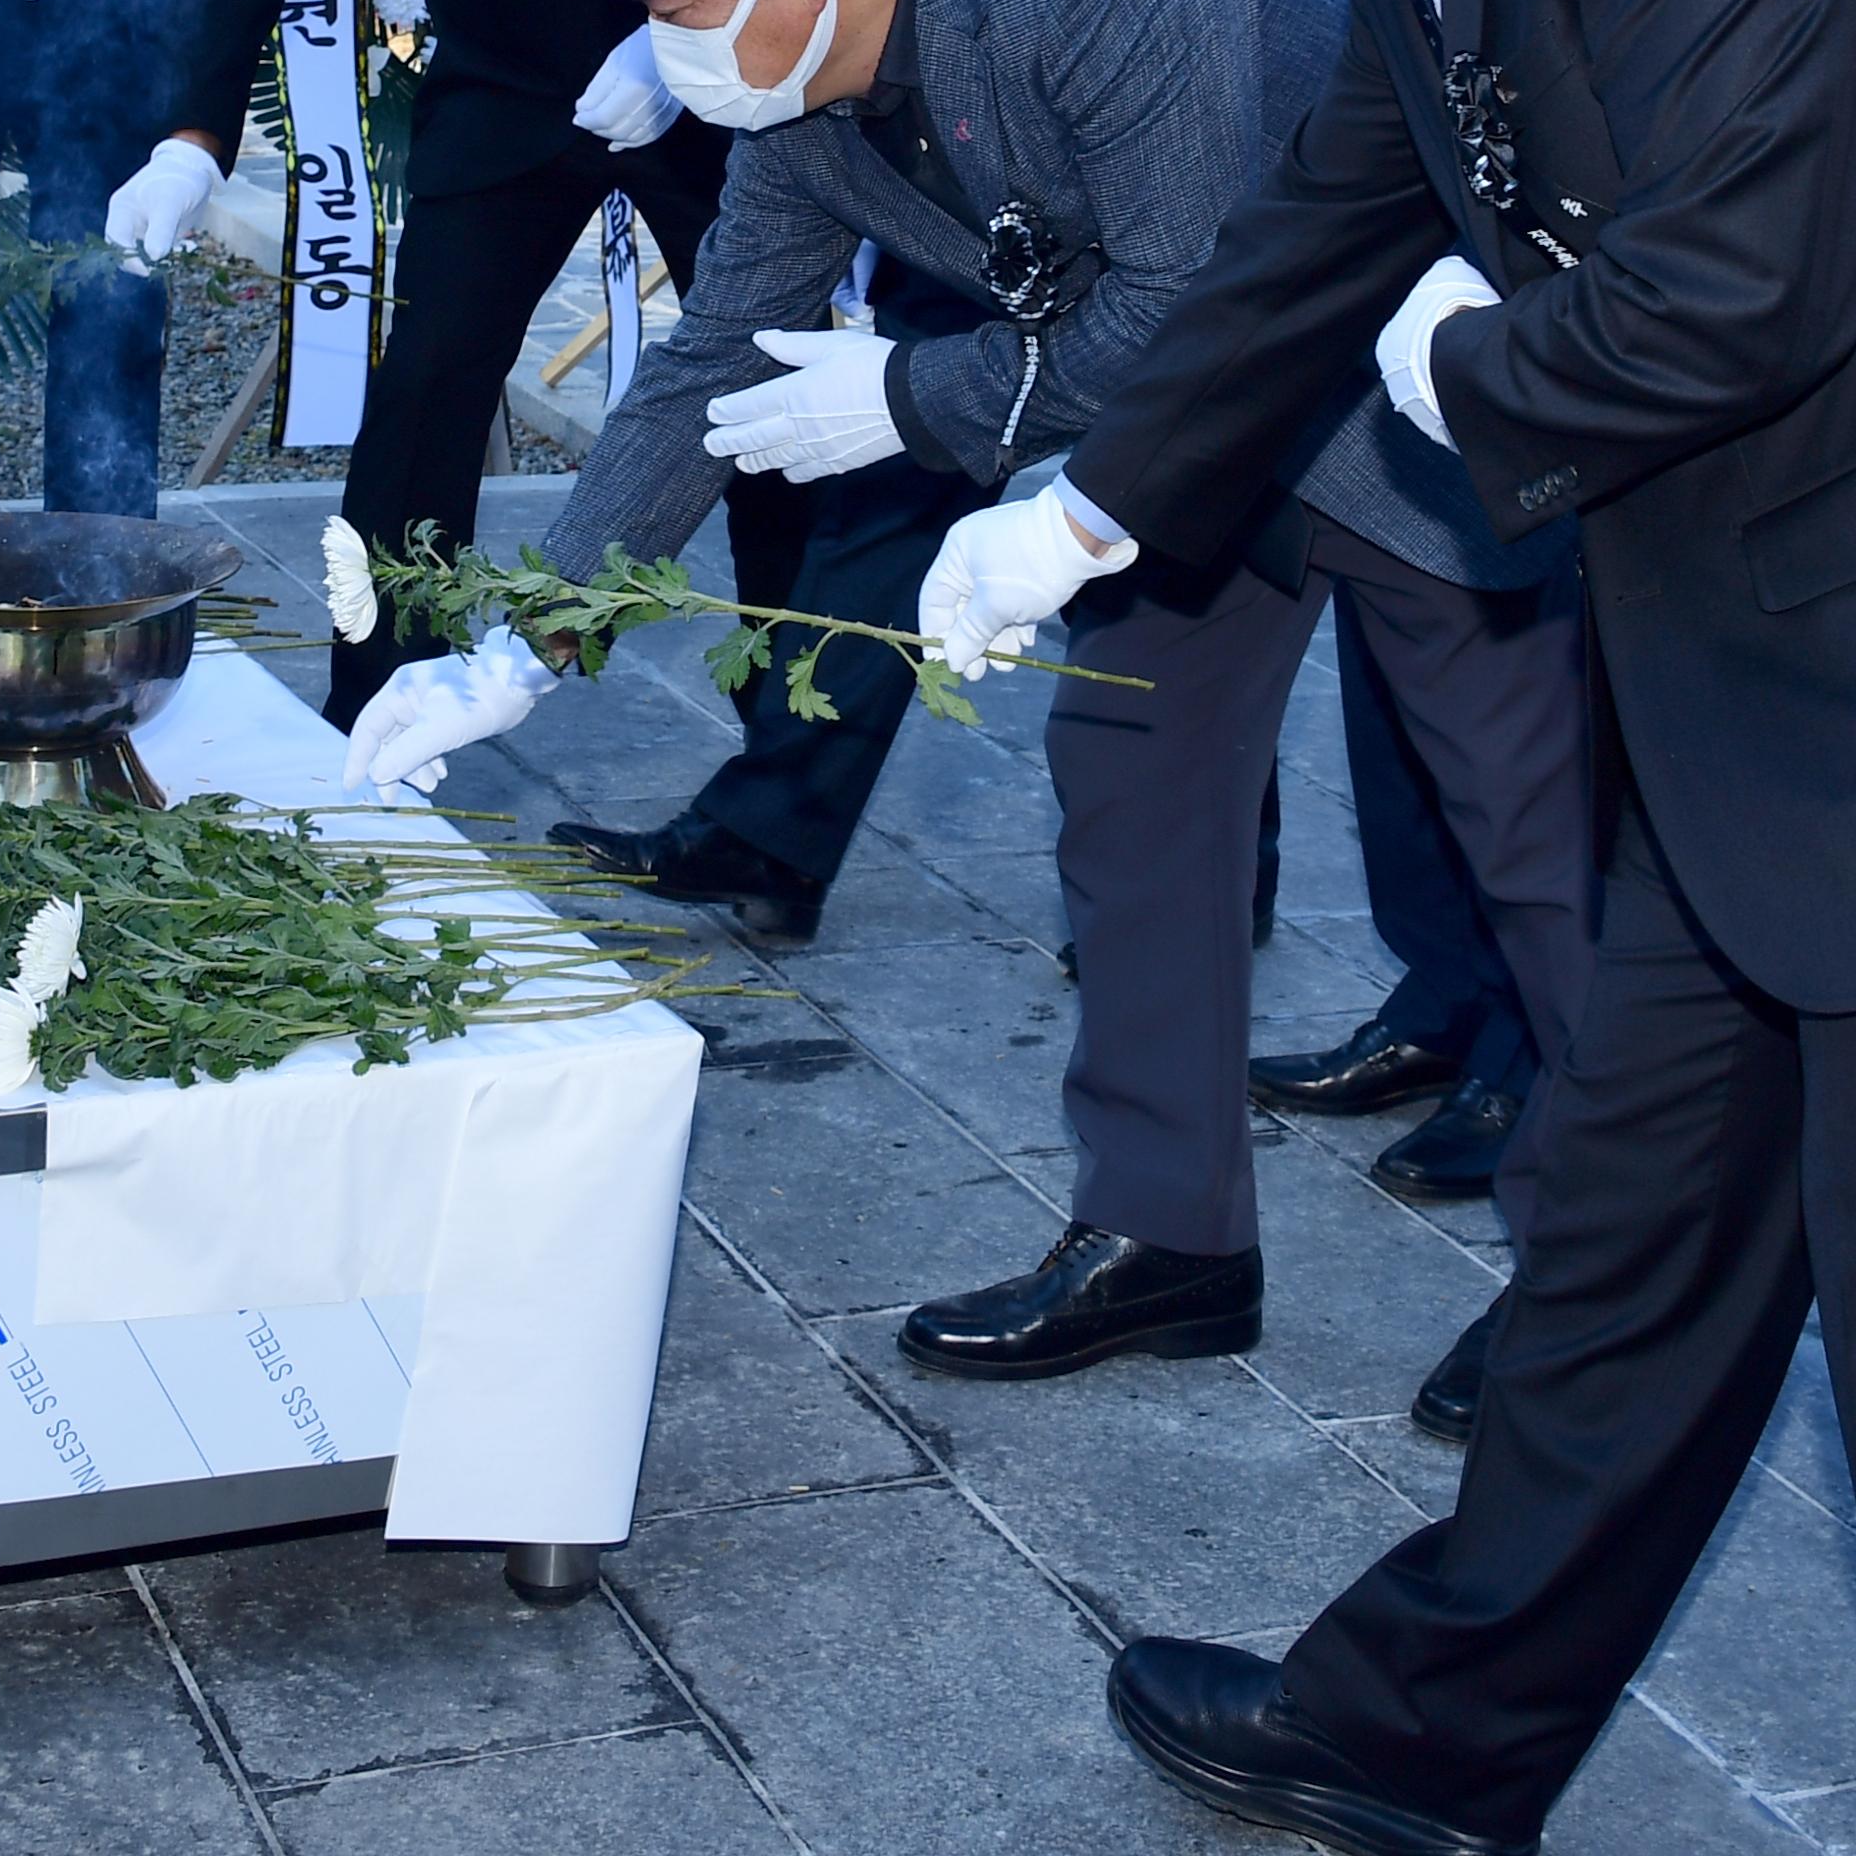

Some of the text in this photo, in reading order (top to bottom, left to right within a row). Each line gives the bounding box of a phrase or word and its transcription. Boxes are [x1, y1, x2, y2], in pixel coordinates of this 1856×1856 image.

[293, 143, 374, 311] 일동
[7, 1347, 58, 1415] STEEL
[245, 1311, 294, 1383] STEEL
